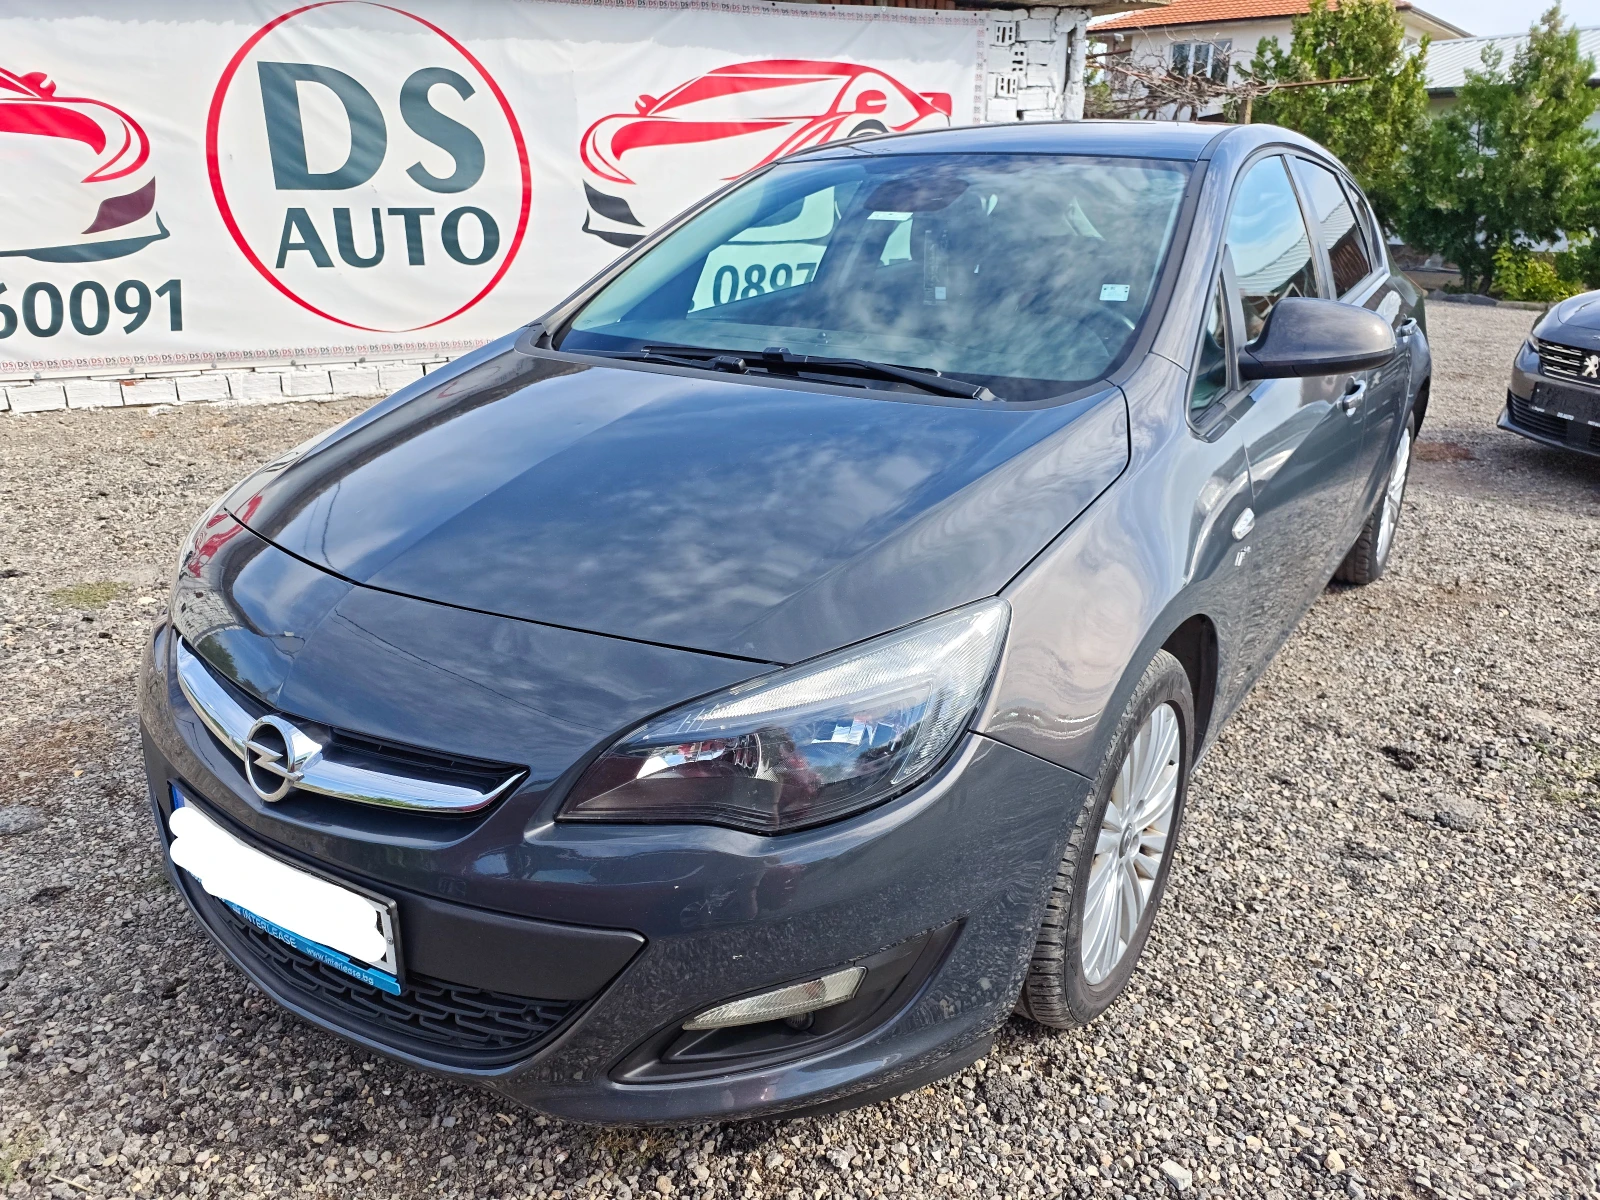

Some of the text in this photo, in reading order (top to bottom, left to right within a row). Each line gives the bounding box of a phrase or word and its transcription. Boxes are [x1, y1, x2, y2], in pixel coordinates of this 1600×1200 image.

[257, 61, 486, 193] DS
[275, 206, 500, 268] AUTO
[243, 909, 374, 985] INTERLEASE www.interlease.bg
